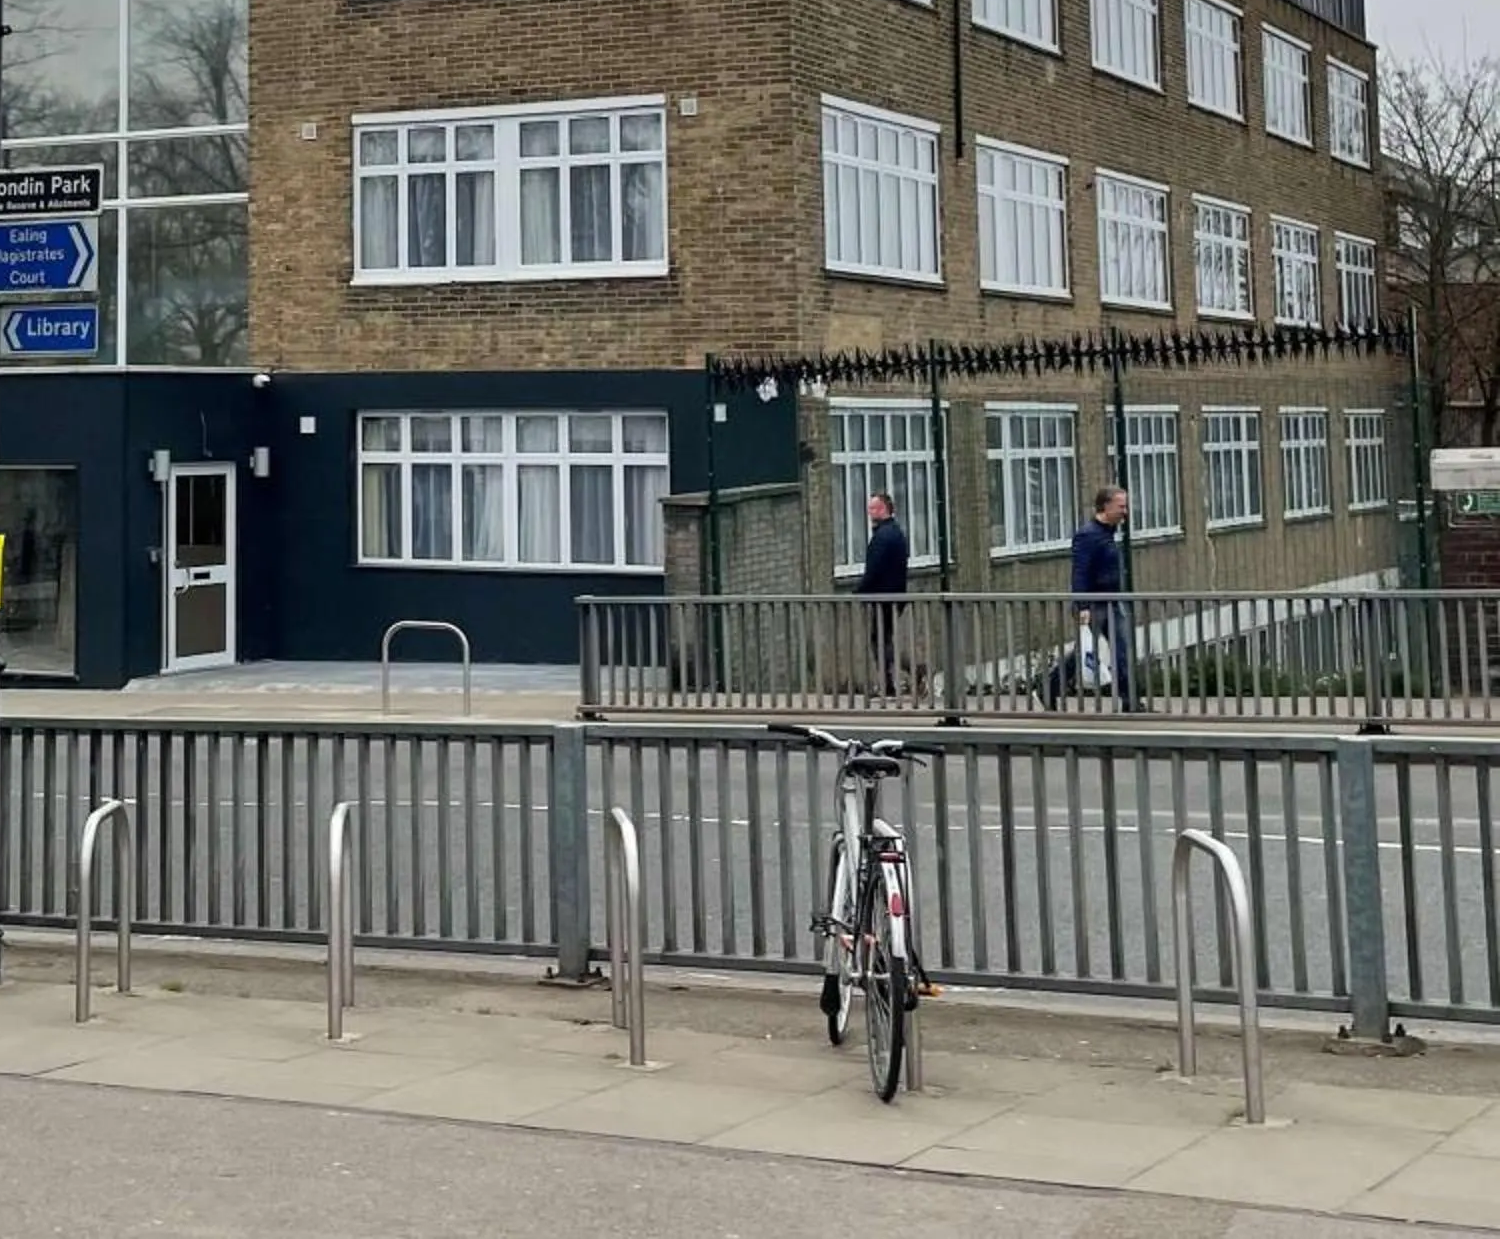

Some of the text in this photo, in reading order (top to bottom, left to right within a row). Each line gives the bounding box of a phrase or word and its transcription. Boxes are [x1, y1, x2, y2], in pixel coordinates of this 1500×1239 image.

[51, 174, 91, 194] Park
[9, 228, 48, 244] Ealing
[9, 271, 46, 284] Court
[26, 316, 91, 339] Library
